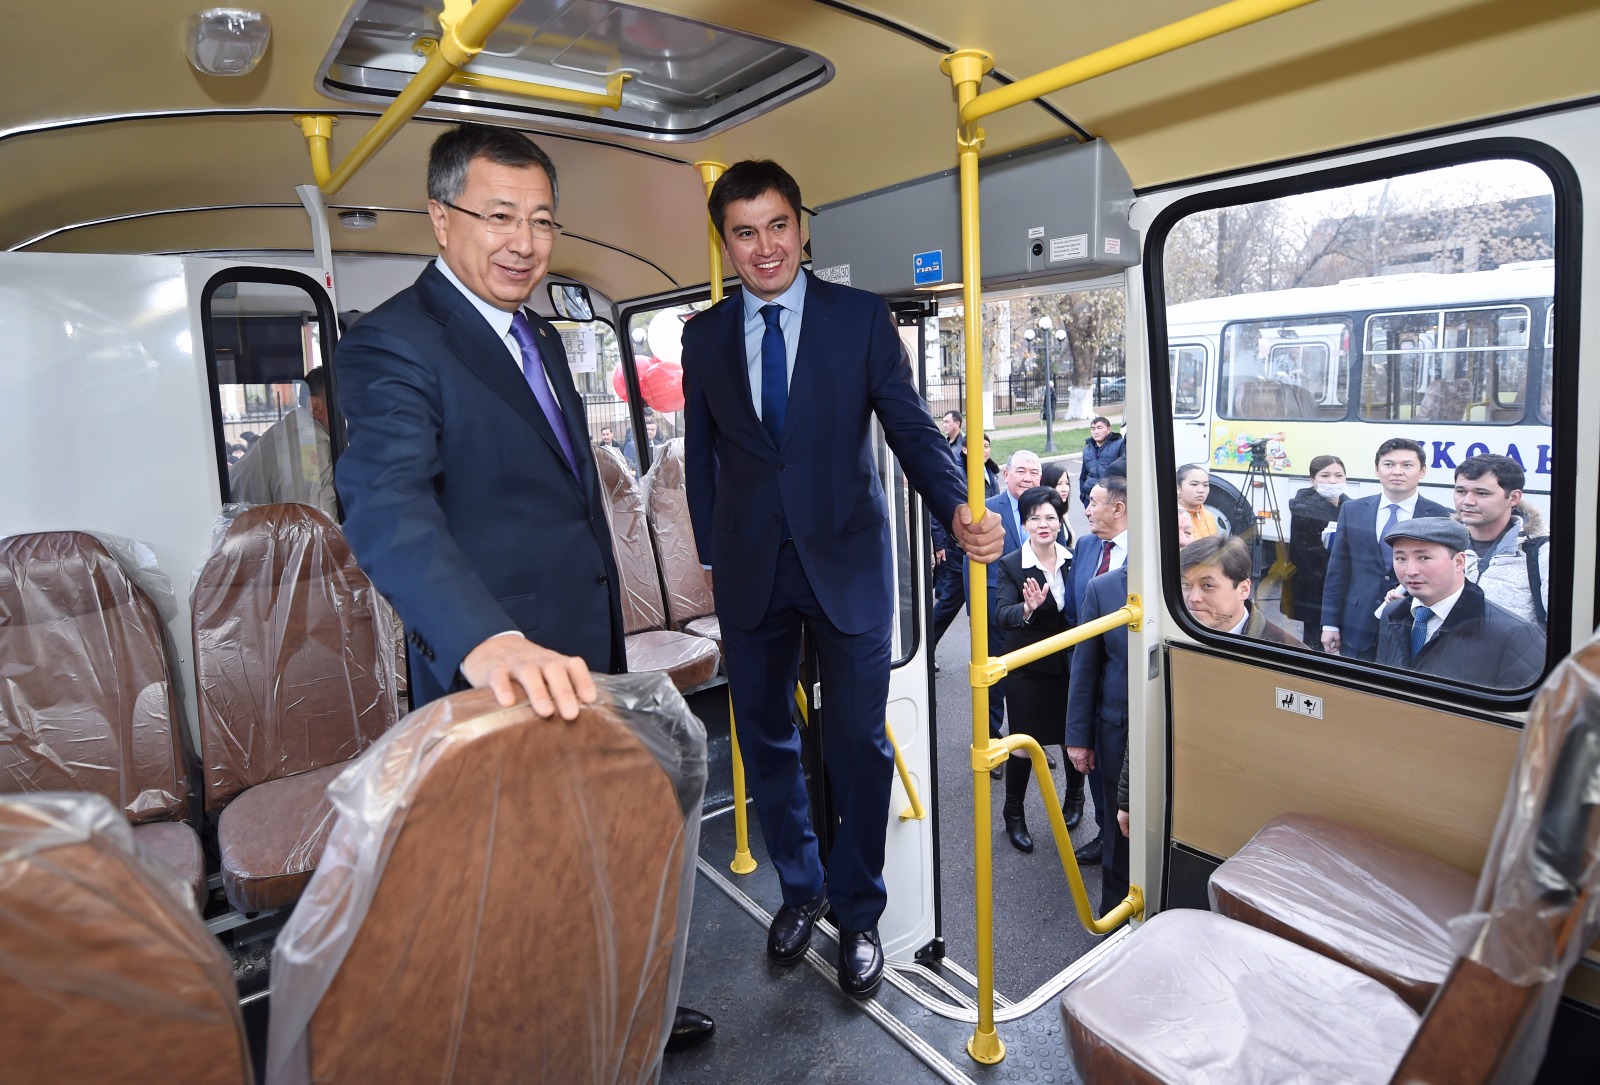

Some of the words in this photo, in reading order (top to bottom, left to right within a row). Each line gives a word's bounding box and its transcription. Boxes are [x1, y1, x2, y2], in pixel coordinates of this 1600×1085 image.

[840, 266, 850, 278] 30
[916, 266, 940, 274] ПАЗ
[1416, 440, 1552, 474] КОЛЬ
